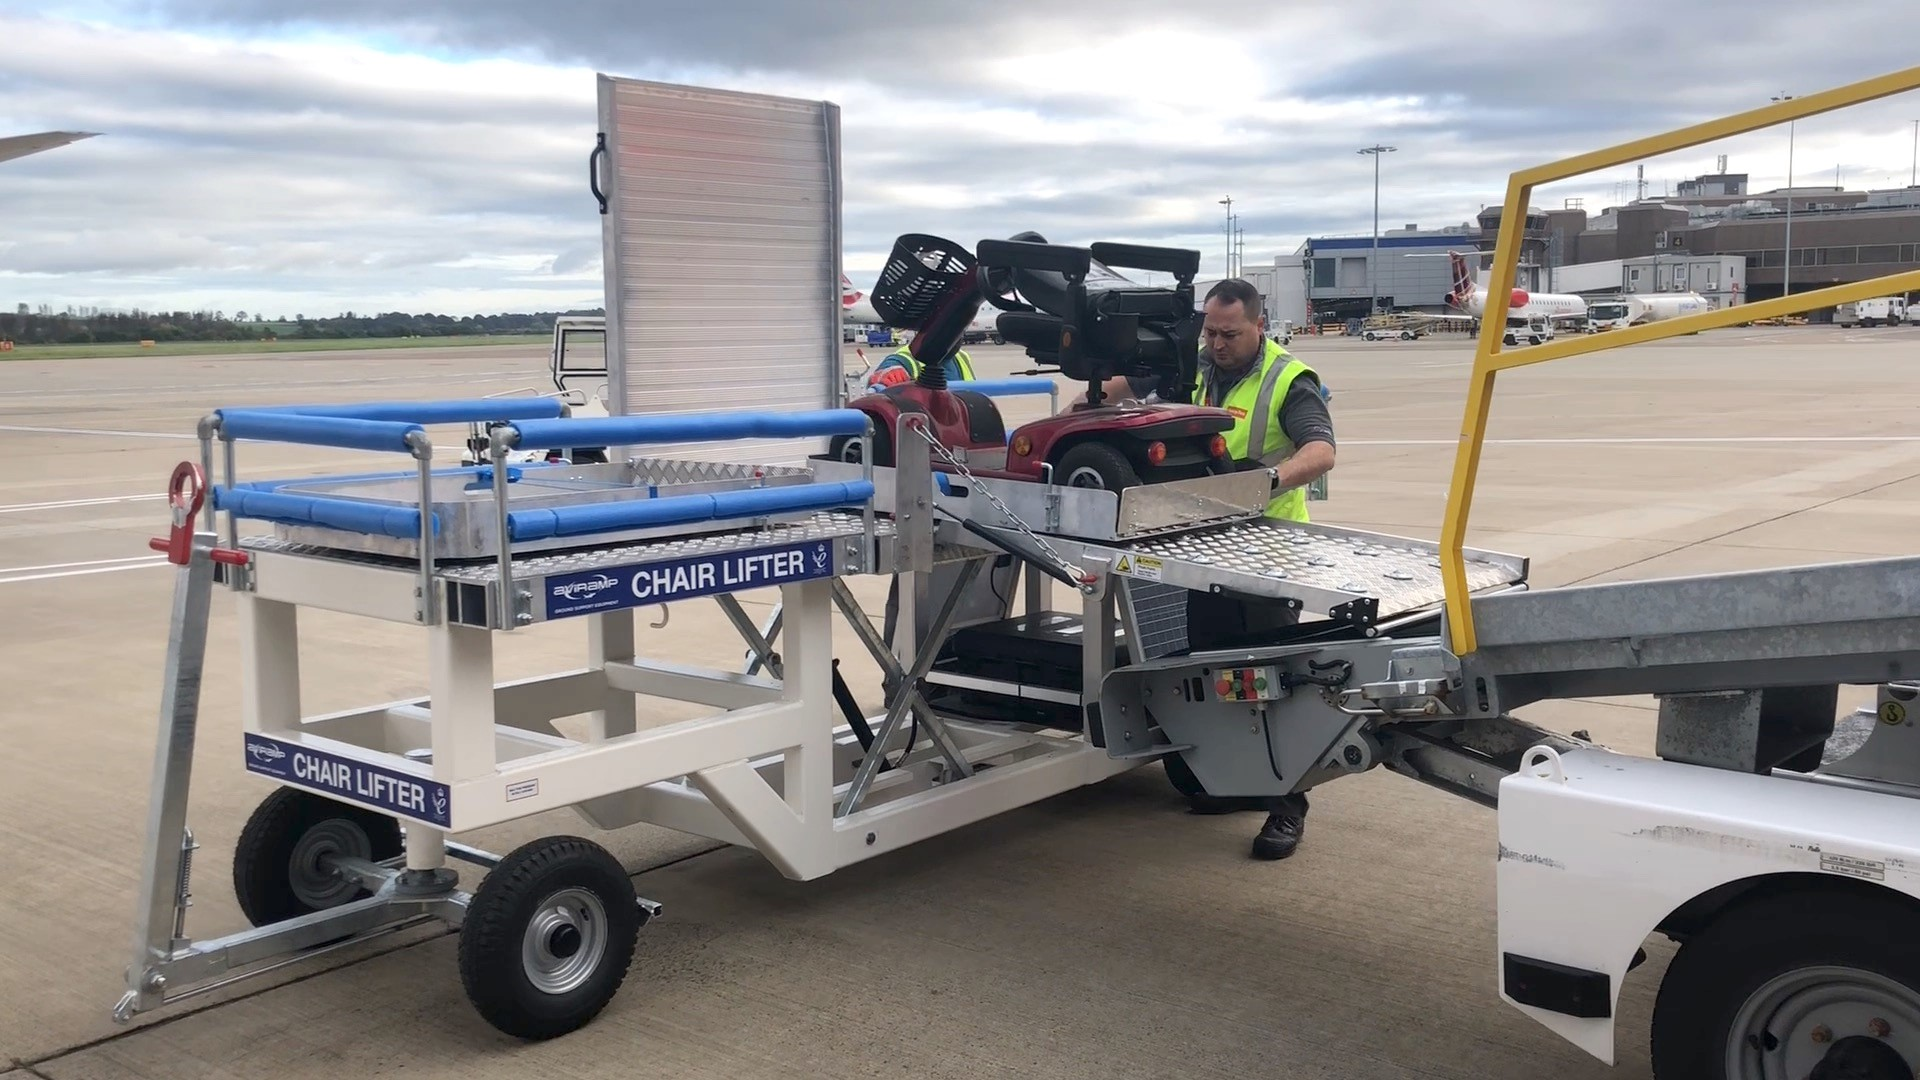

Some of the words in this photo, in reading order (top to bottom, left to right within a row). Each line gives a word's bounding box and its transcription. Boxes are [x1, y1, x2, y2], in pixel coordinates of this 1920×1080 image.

[632, 562, 716, 599] CHAIR
[723, 550, 804, 585] LIFTER
[554, 606, 574, 614] GROUND
[574, 603, 595, 611] SUPPORT
[595, 600, 619, 608] EQUIPMENT
[292, 752, 352, 791] CHAIR
[356, 768, 426, 813] LIFTER
